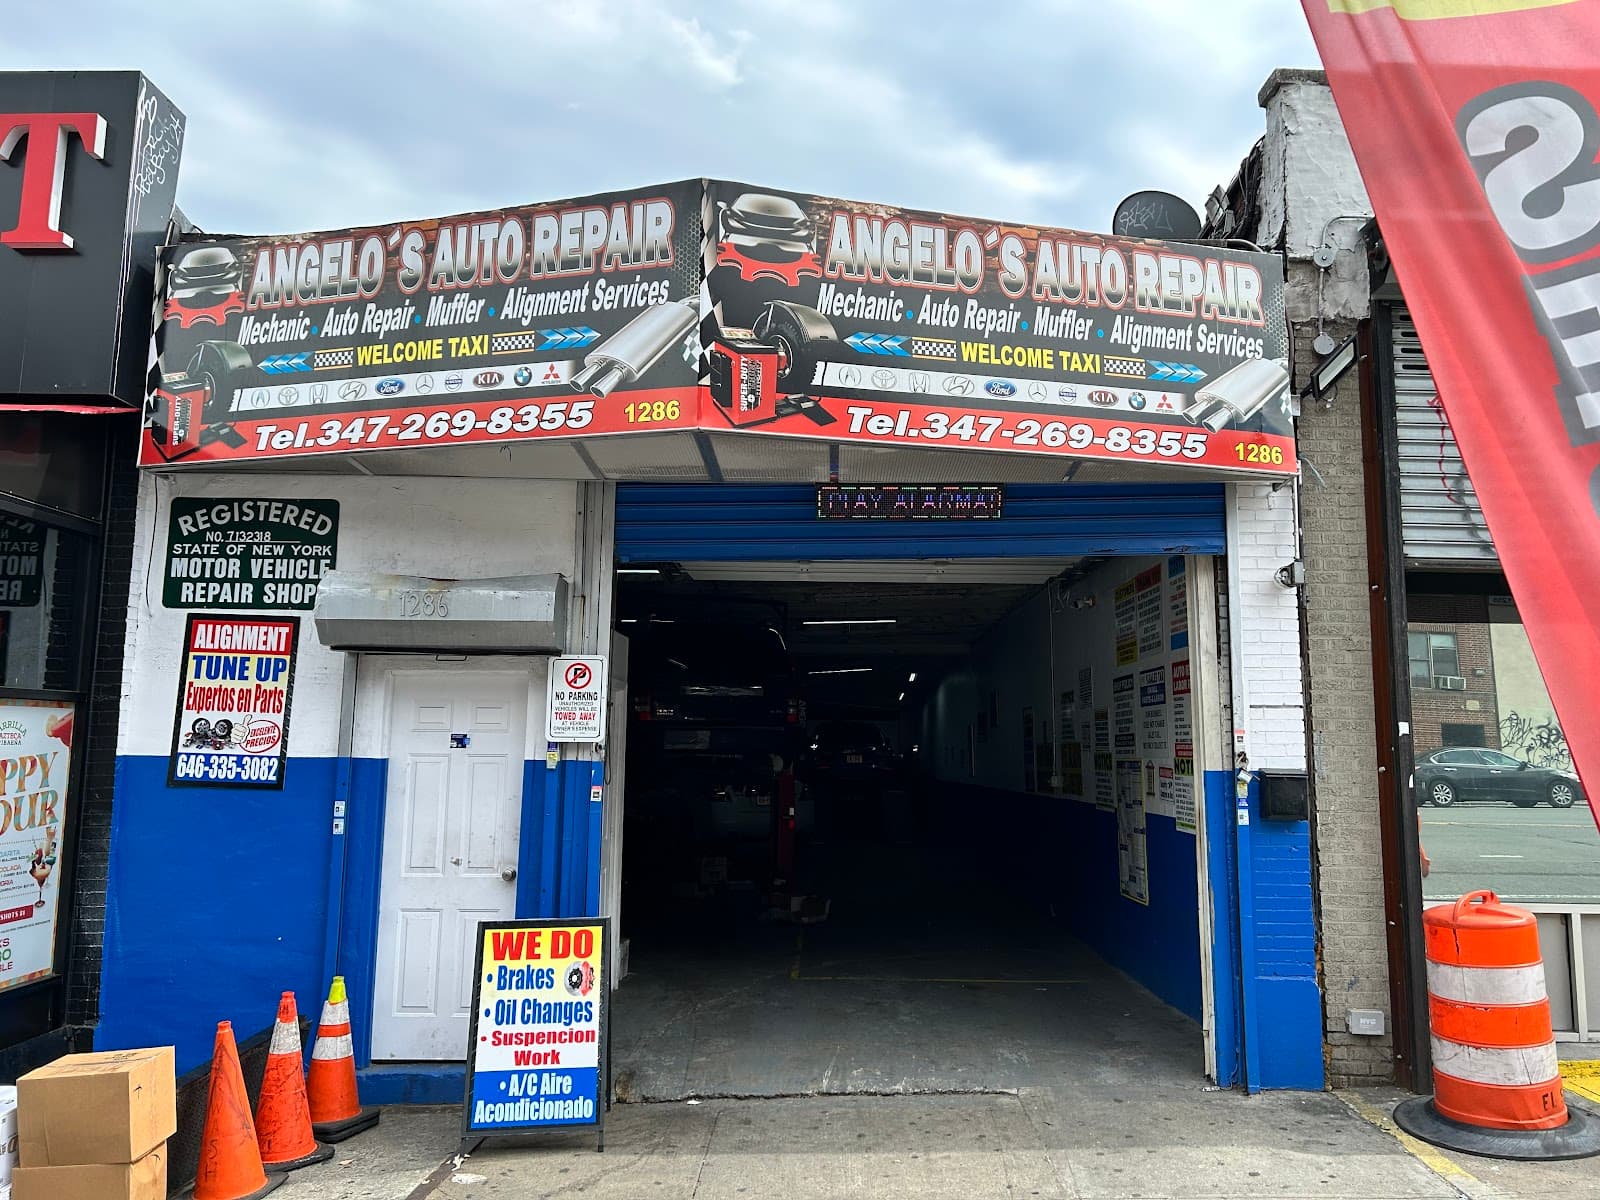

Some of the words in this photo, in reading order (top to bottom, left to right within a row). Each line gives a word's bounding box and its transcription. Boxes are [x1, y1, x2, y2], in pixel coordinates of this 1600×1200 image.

[430, 215, 525, 289] AUTO
[531, 199, 674, 279] REPAIR
[1033, 235, 1128, 308] AUTO
[1133, 249, 1265, 326] REPAIR
[239, 314, 310, 346] Mechanic
[320, 307, 357, 338] Auto
[362, 302, 415, 336] Repair
[426, 295, 485, 326] Muffler
[502, 282, 589, 322] Alignment
[592, 277, 669, 309] Services
[817, 283, 903, 322] Mechanic
[918, 294, 960, 330] Auto
[964, 300, 1021, 341] Repair
[1033, 306, 1093, 341] Muffler
[1110, 315, 1191, 354] Alignment
[1196, 325, 1264, 360] Services
[357, 343, 443, 367] WELCOME
[448, 335, 489, 359] TAXI
[961, 342, 1055, 371] WELCOME
[1059, 350, 1101, 374] TAXI
[477, 372, 501, 386] KIA
[1091, 391, 1117, 406] KIA
[624, 400, 681, 424] 1286
[255, 400, 594, 451] Tel.347-269-8355
[848, 406, 1209, 461] Tel.347-269-8355
[1235, 442, 1283, 466] 1286
[177, 501, 333, 536] REGISTERED
[205, 531, 225, 542] NO.
[227, 531, 271, 542] 7132318
[172, 544, 219, 555] STATE
[226, 544, 246, 555] OF
[252, 545, 284, 556] NEW
[291, 545, 332, 556] YORK
[171, 558, 241, 578] MOTOR
[251, 558, 331, 579] VEHICLE
[181, 582, 254, 603] REPAIR
[262, 583, 318, 604] SHOP
[400, 592, 449, 618] 1286
[194, 624, 289, 652] ALIGNMENT
[193, 655, 250, 681] TUNE
[256, 657, 287, 682] UP
[186, 681, 235, 714] Expertos
[237, 690, 252, 713] en
[254, 683, 284, 714] Parts
[556, 691, 564, 701] NO
[569, 691, 598, 701] PARKING
[555, 712, 576, 720] TOWED
[580, 712, 595, 720] AWAY
[245, 735, 276, 749] PRECIOS
[250, 725, 276, 738] EXCELENTE
[176, 755, 277, 781] 646-335-3082
[492, 931, 541, 961] WE
[550, 929, 594, 960] DO
[496, 965, 555, 991] Brakes
[495, 999, 517, 1026] Oil
[520, 999, 593, 1027] Changes
[491, 1028, 596, 1047] Suspencion
[514, 1049, 561, 1066] Work
[508, 1073, 537, 1097] A/C
[540, 1072, 573, 1095] Aire
[474, 1096, 594, 1124] Acondicionado
